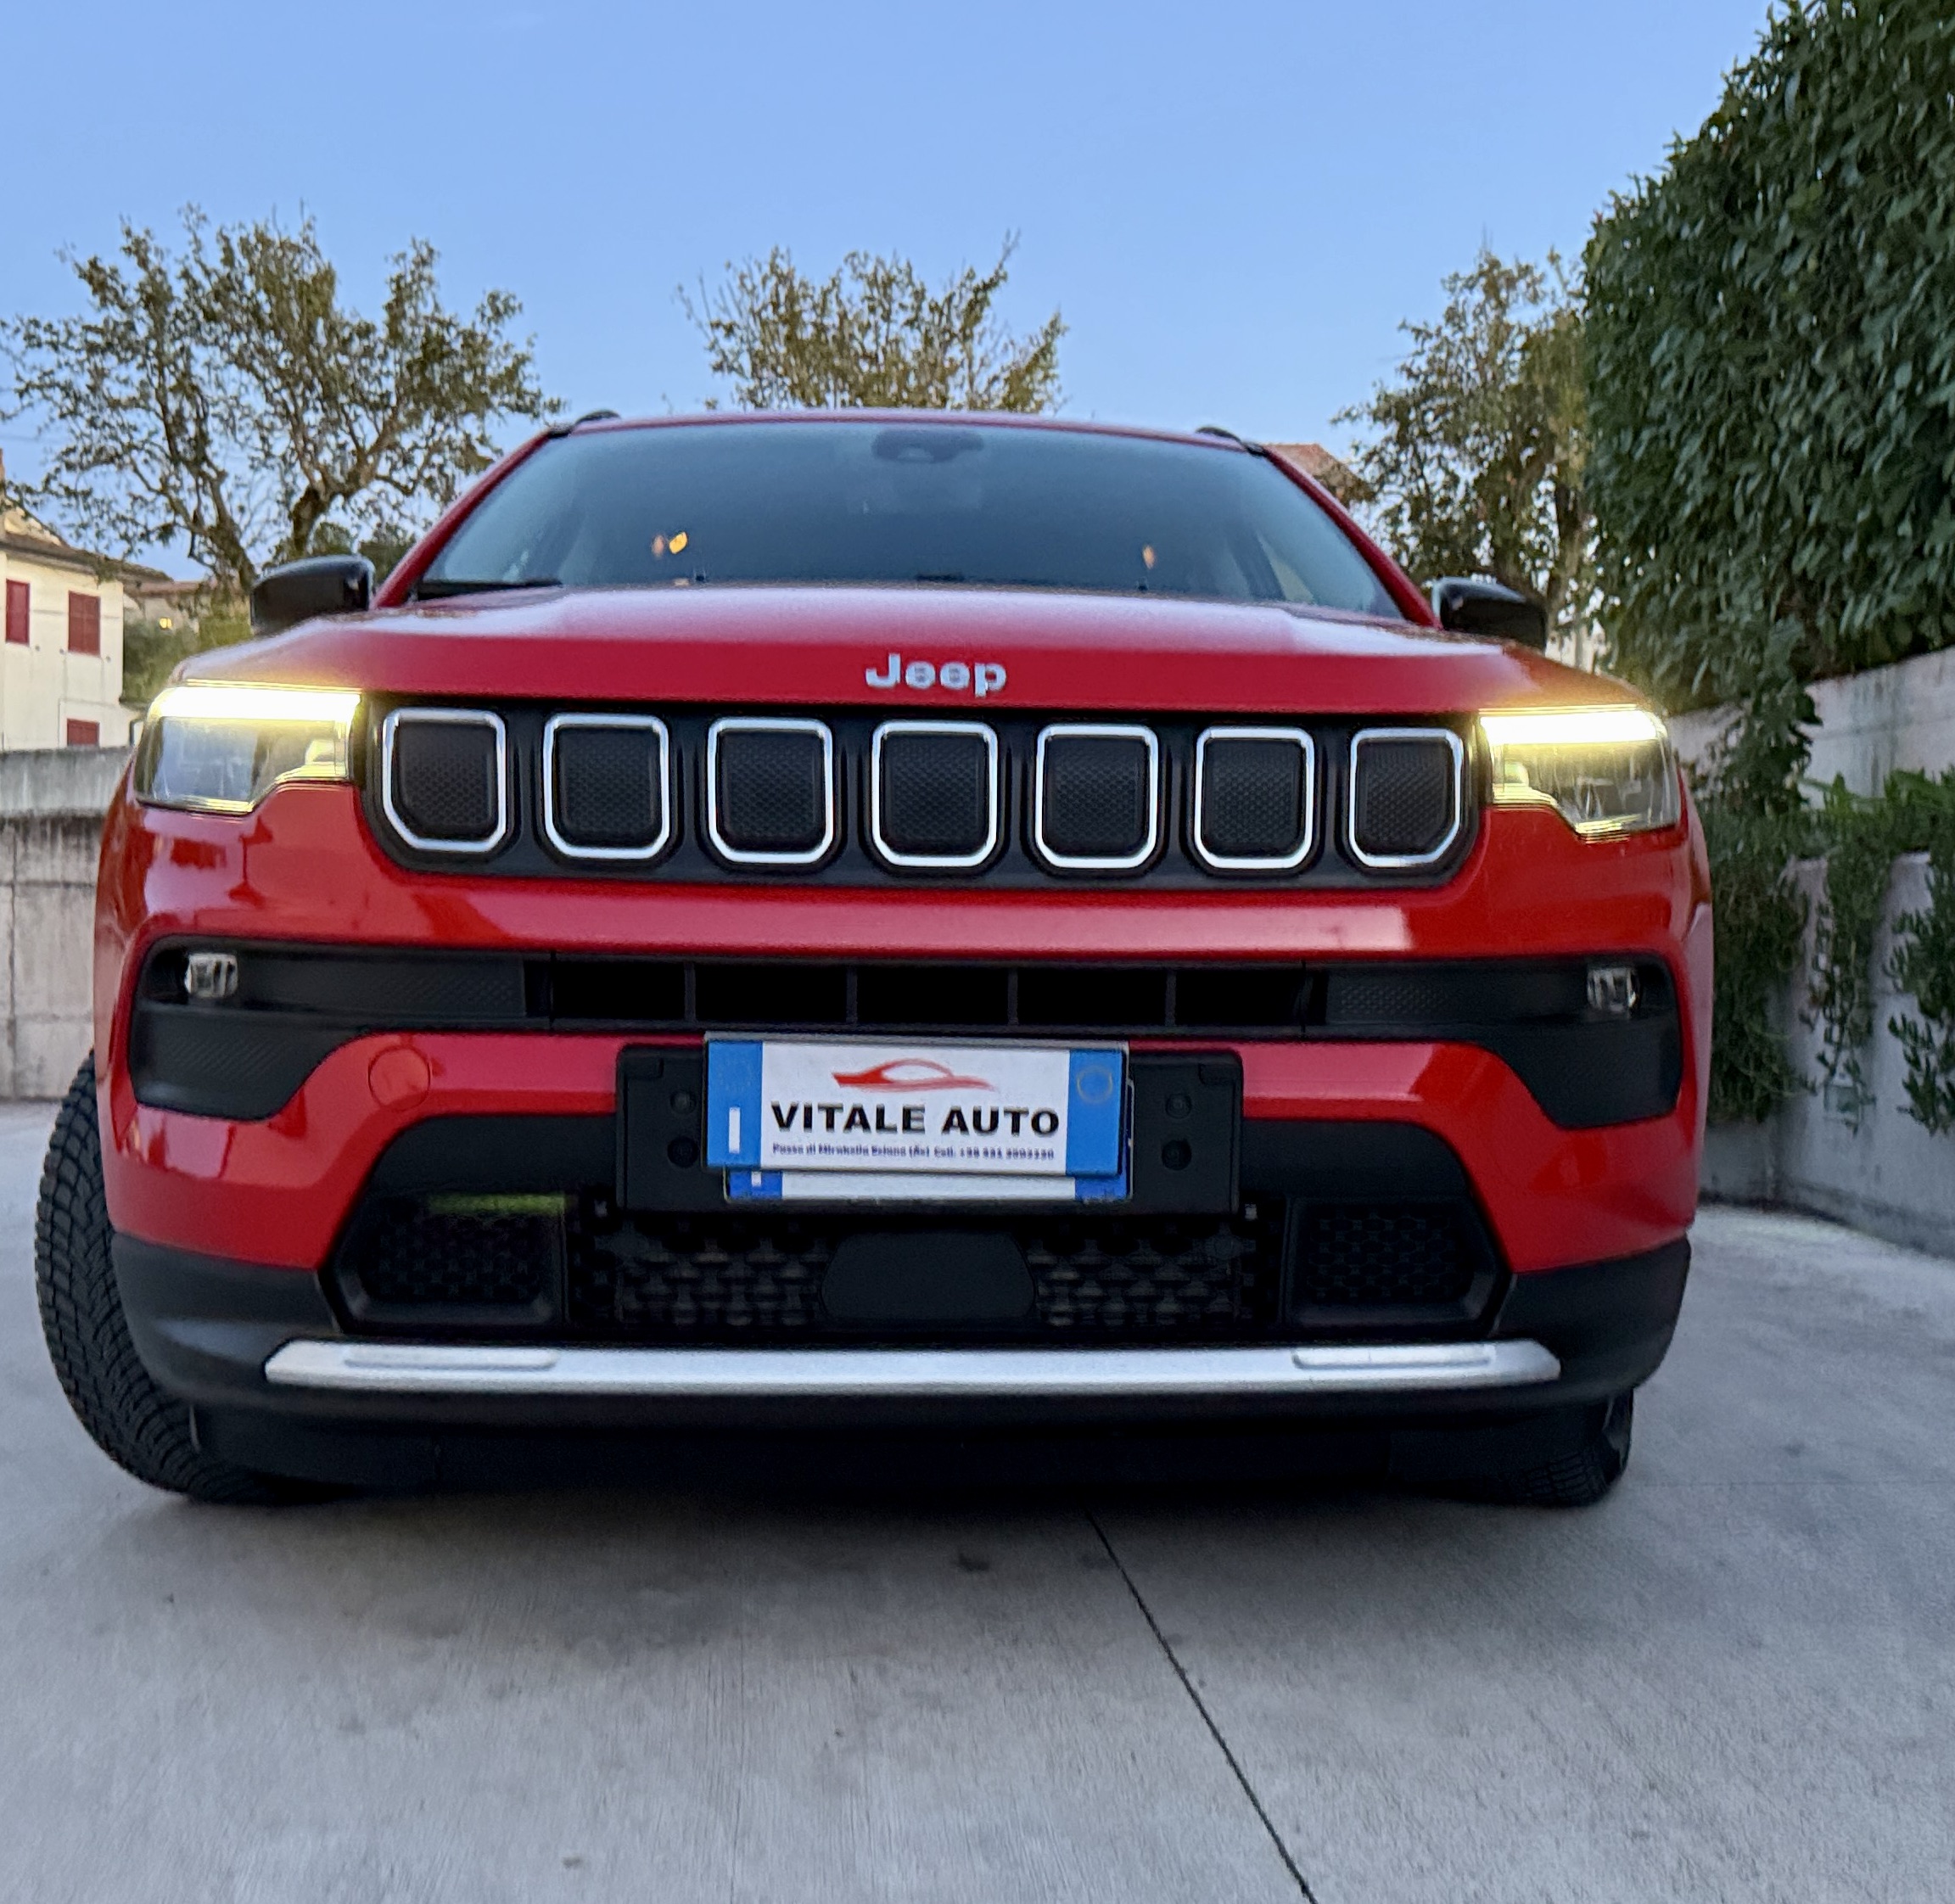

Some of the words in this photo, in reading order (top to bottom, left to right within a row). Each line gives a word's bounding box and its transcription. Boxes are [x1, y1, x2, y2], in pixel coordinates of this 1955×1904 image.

[865, 652, 1007, 697] Jeep
[770, 1100, 927, 1134] VITALE
[941, 1105, 1061, 1137] AUTO
